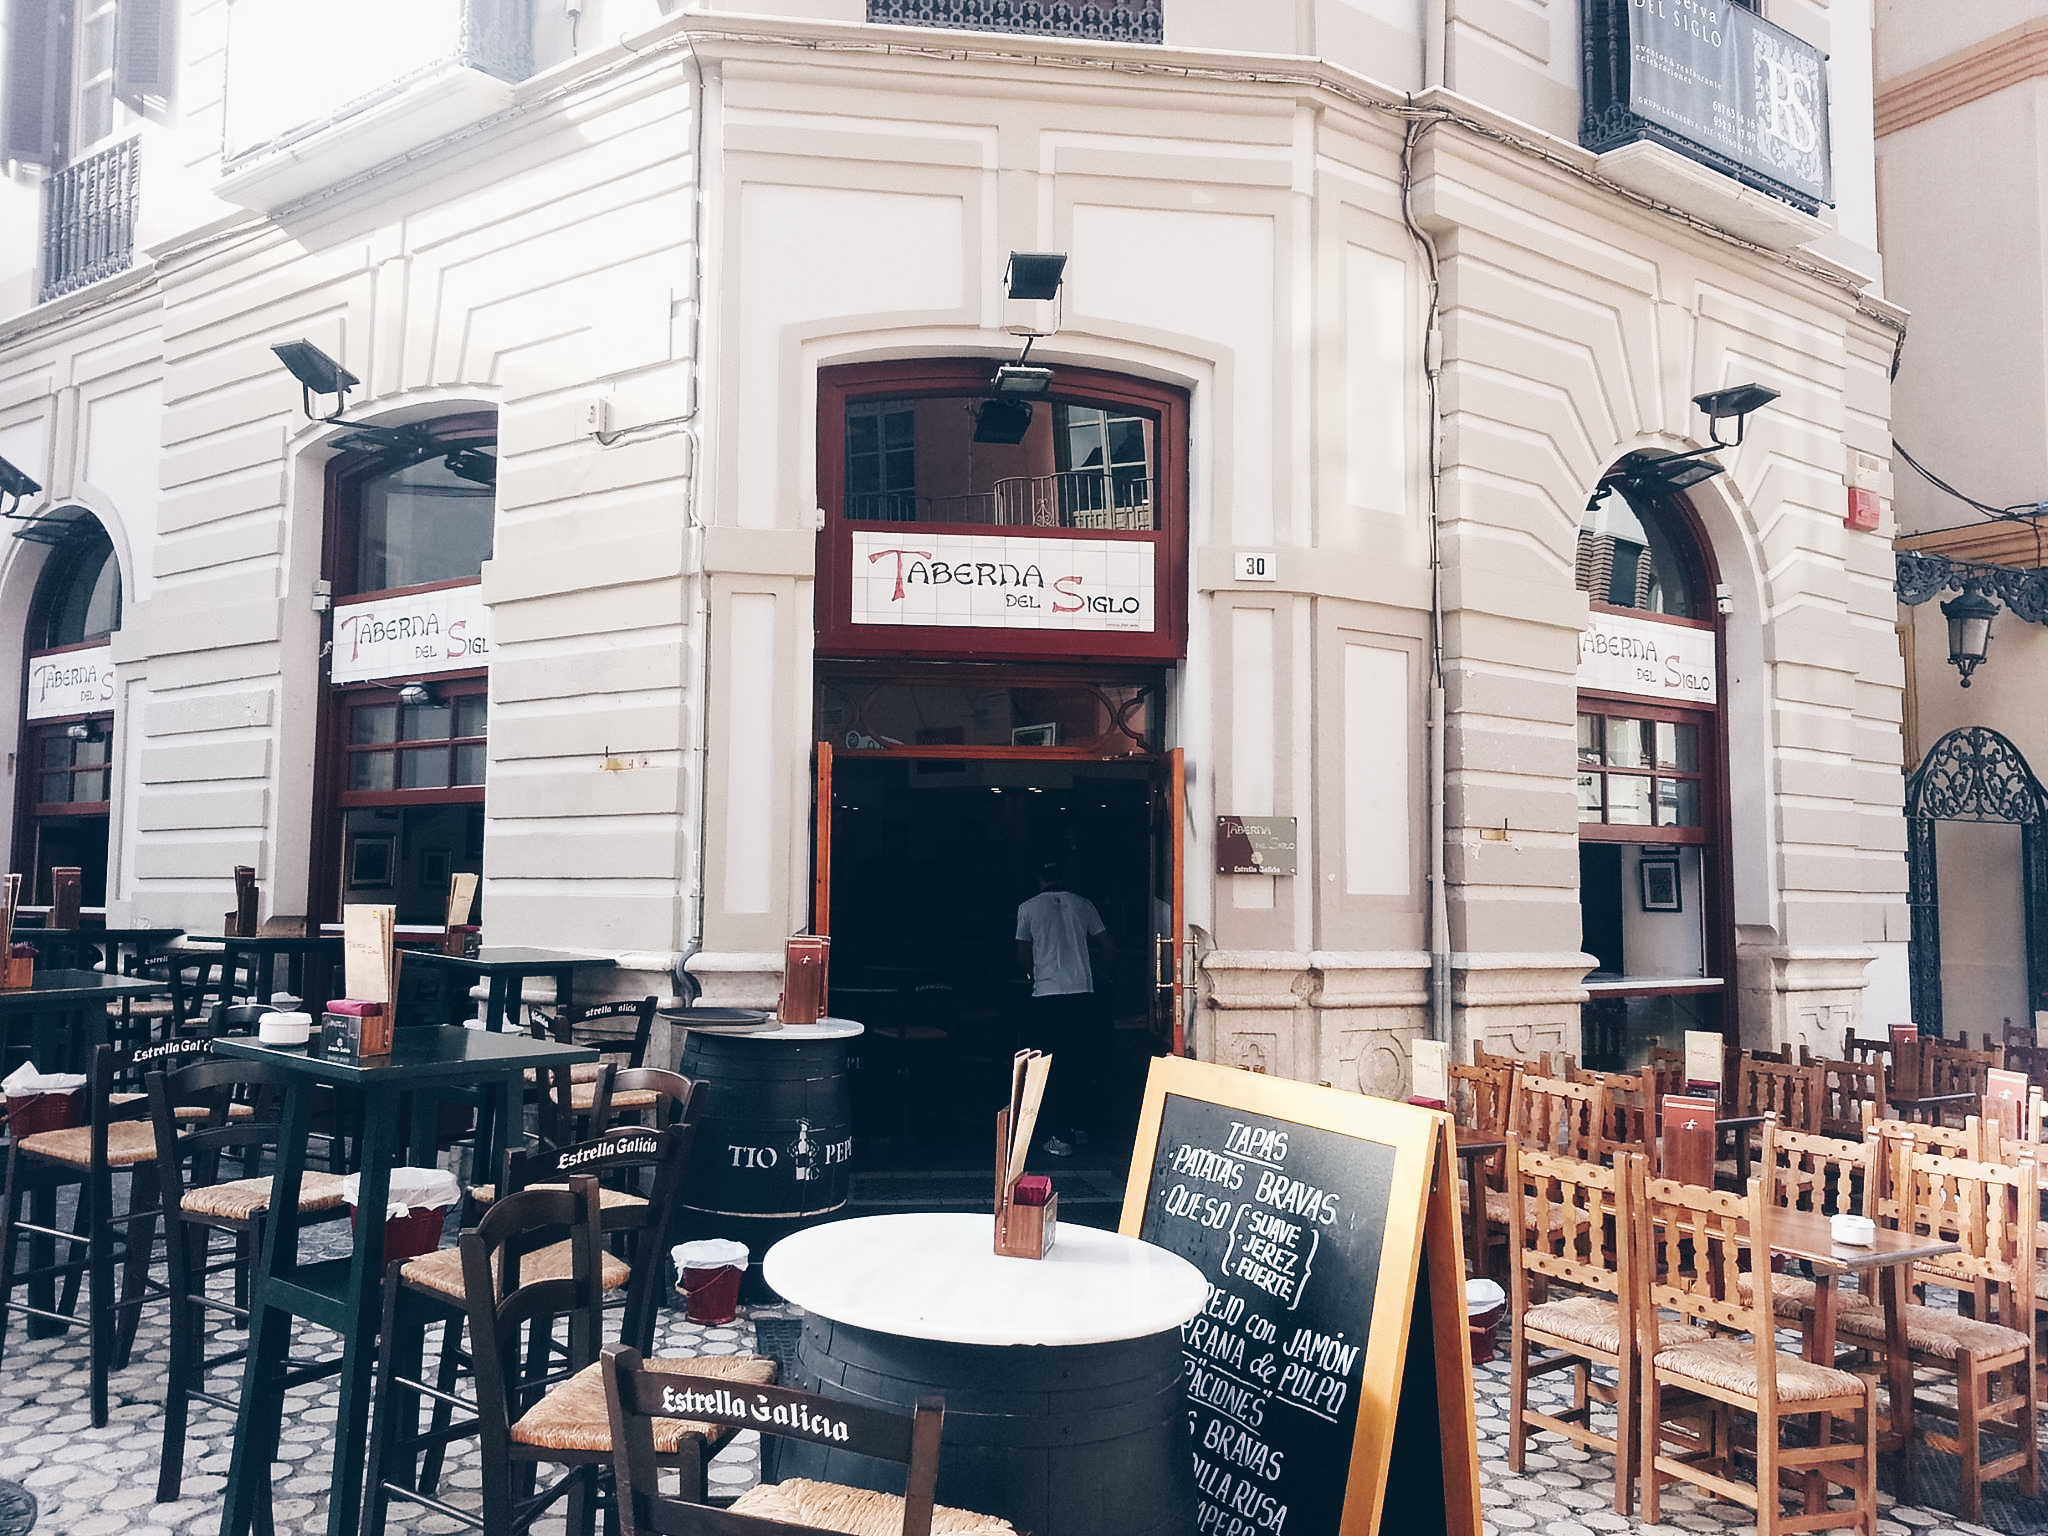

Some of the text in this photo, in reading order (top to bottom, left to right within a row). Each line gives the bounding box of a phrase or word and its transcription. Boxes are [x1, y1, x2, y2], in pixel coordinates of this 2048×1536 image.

[1673, 10, 1722, 48] SIGLO
[868, 549, 1045, 601] TABERNA
[1246, 557, 1265, 575] 30
[1005, 576, 1140, 615] DEL SIGLO
[341, 612, 440, 662] TABERNA
[414, 645, 437, 659] DEL
[1577, 623, 1658, 664] ABERNA
[34, 663, 97, 702] TABERNA
[1637, 655, 1711, 691] DEL SIGLO
[80, 689, 95, 702] DEL
[585, 1003, 637, 1018] strella alicia
[132, 1043, 180, 1062] Estrella
[556, 1137, 657, 1169] Estrella Galicia
[727, 1135, 852, 1169] TIO PEP
[1224, 1121, 1289, 1161] TAPAS
[1171, 1144, 1341, 1225] PATATAS BRAVAS
[1165, 1184, 1232, 1230] QUESO
[1247, 1211, 1302, 1248] SUAVE
[1241, 1234, 1299, 1276] JEREZ
[1235, 1257, 1296, 1302] FUERTE
[1245, 1314, 1277, 1345] con
[1249, 1352, 1277, 1384] de
[1277, 1362, 1347, 1415] PULPO
[661, 1385, 850, 1442] Estrella Galicia
[1203, 1418, 1285, 1481] BRAVAS
[1229, 1479, 1288, 1536] RUSA
